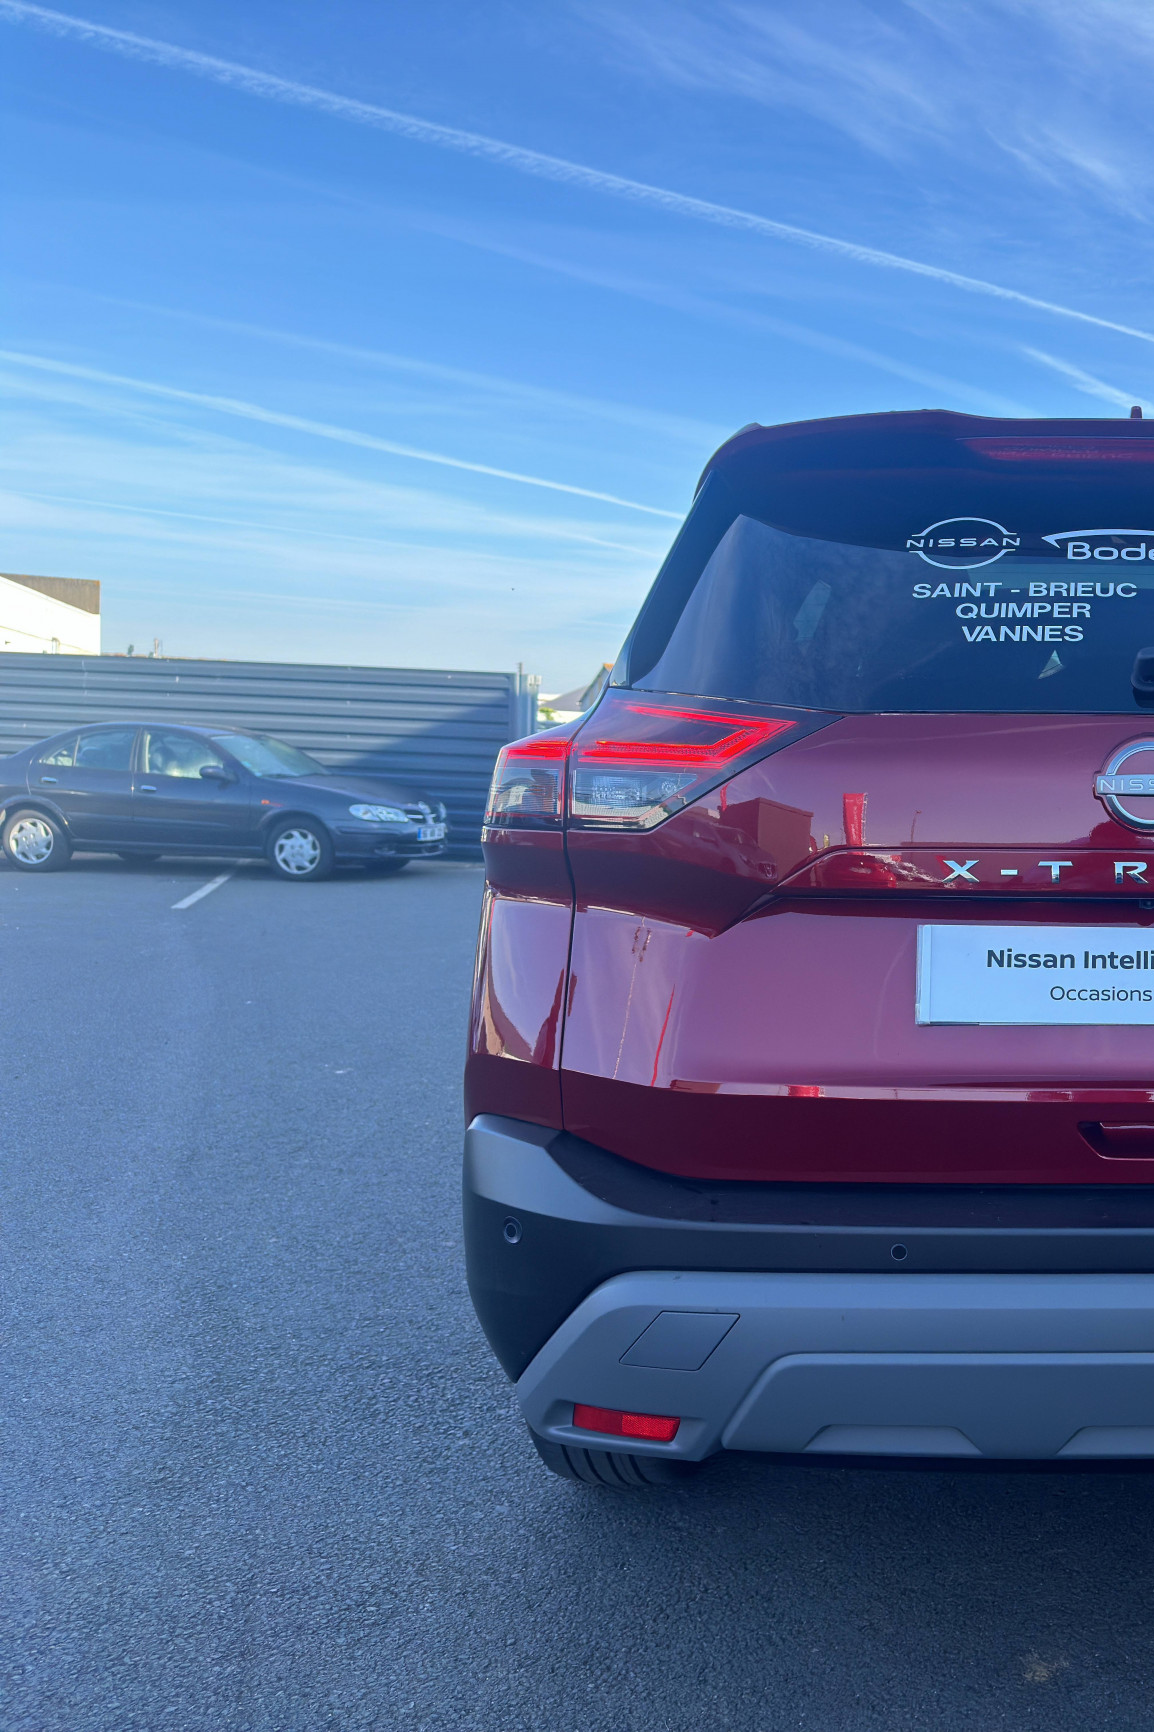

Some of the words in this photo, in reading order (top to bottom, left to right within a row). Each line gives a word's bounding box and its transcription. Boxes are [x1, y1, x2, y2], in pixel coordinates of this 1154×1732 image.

[906, 537, 1021, 548] NISSAN
[911, 582, 1002, 599] SAINT
[1028, 582, 1138, 598] BRIEUC
[955, 602, 1091, 619] QUIMPER
[961, 625, 1084, 643] VANNES
[986, 949, 1075, 969] Nissan
[1049, 985, 1153, 1003] Occasions
